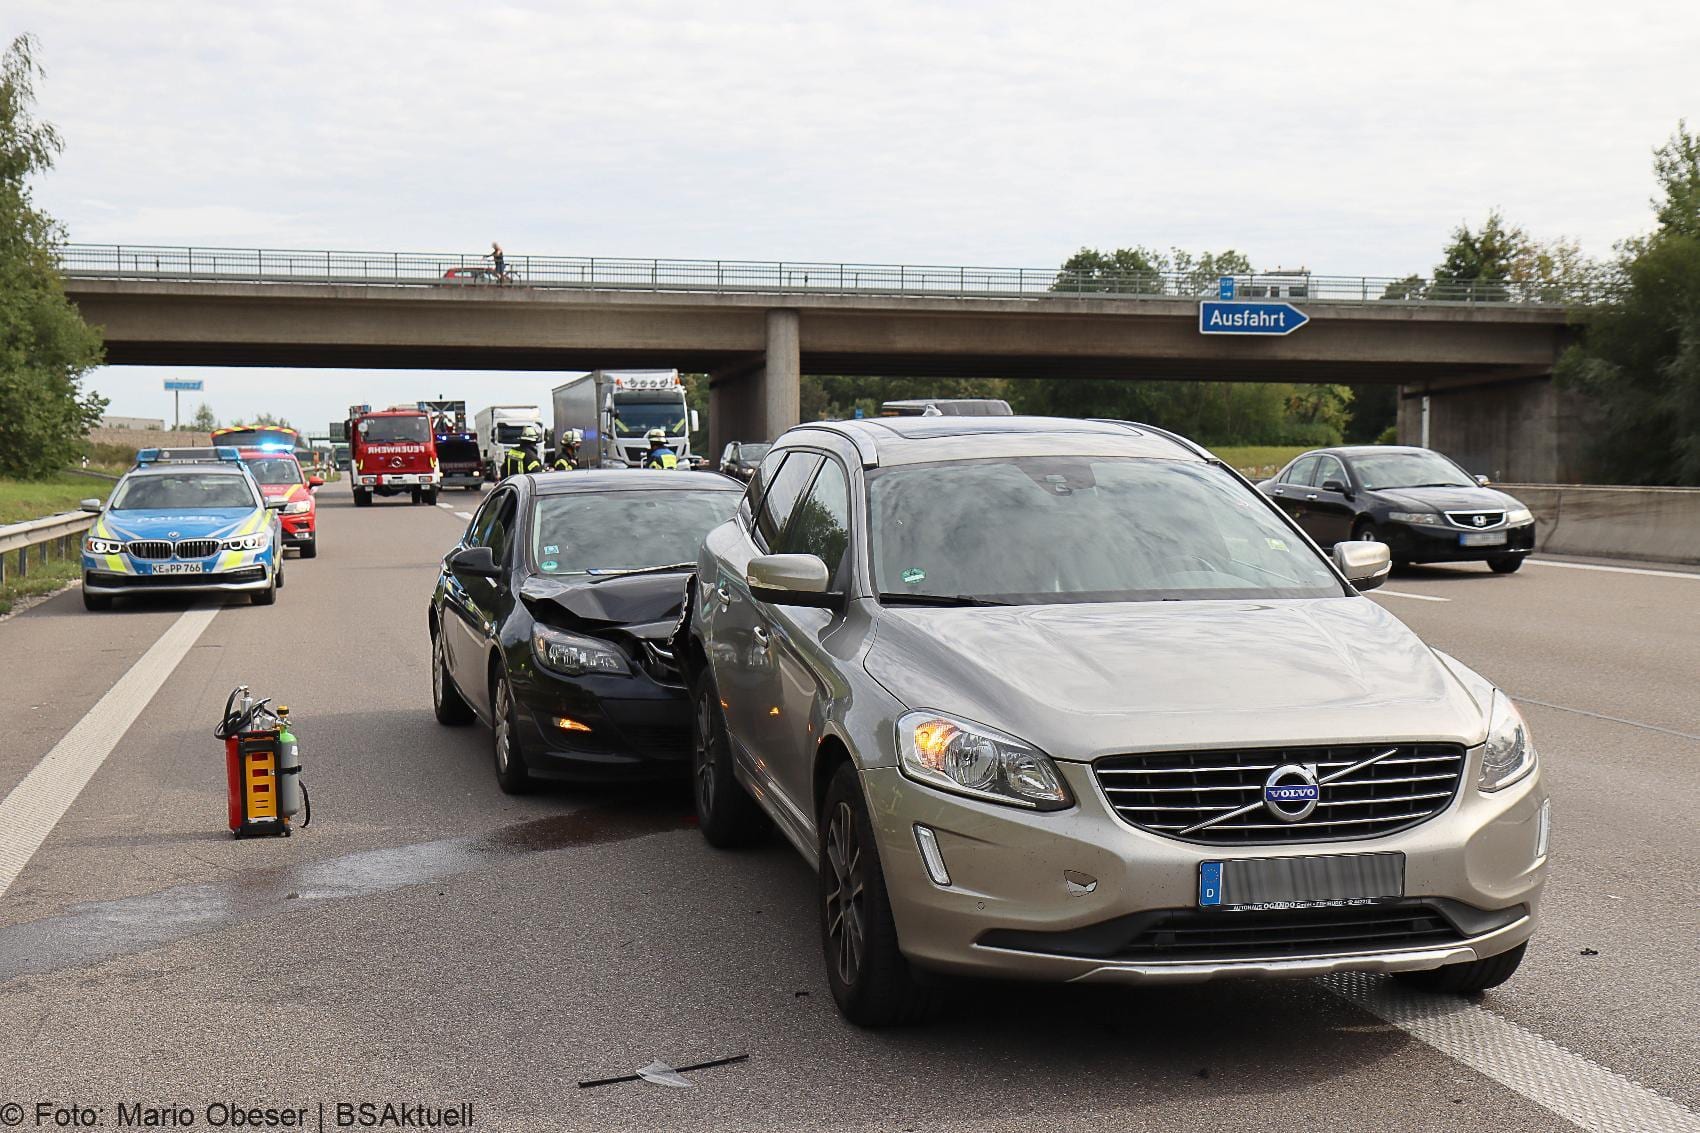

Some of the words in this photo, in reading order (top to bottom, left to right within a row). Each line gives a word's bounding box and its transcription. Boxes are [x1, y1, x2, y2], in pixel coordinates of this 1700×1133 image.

[1209, 309, 1286, 327] Ausfahrt
[152, 564, 165, 574] KE
[170, 564, 182, 573] PP
[183, 563, 201, 573] 766
[1268, 788, 1315, 798] VOLVO
[1206, 888, 1215, 898] D
[1263, 901, 1296, 910] OGANDO
